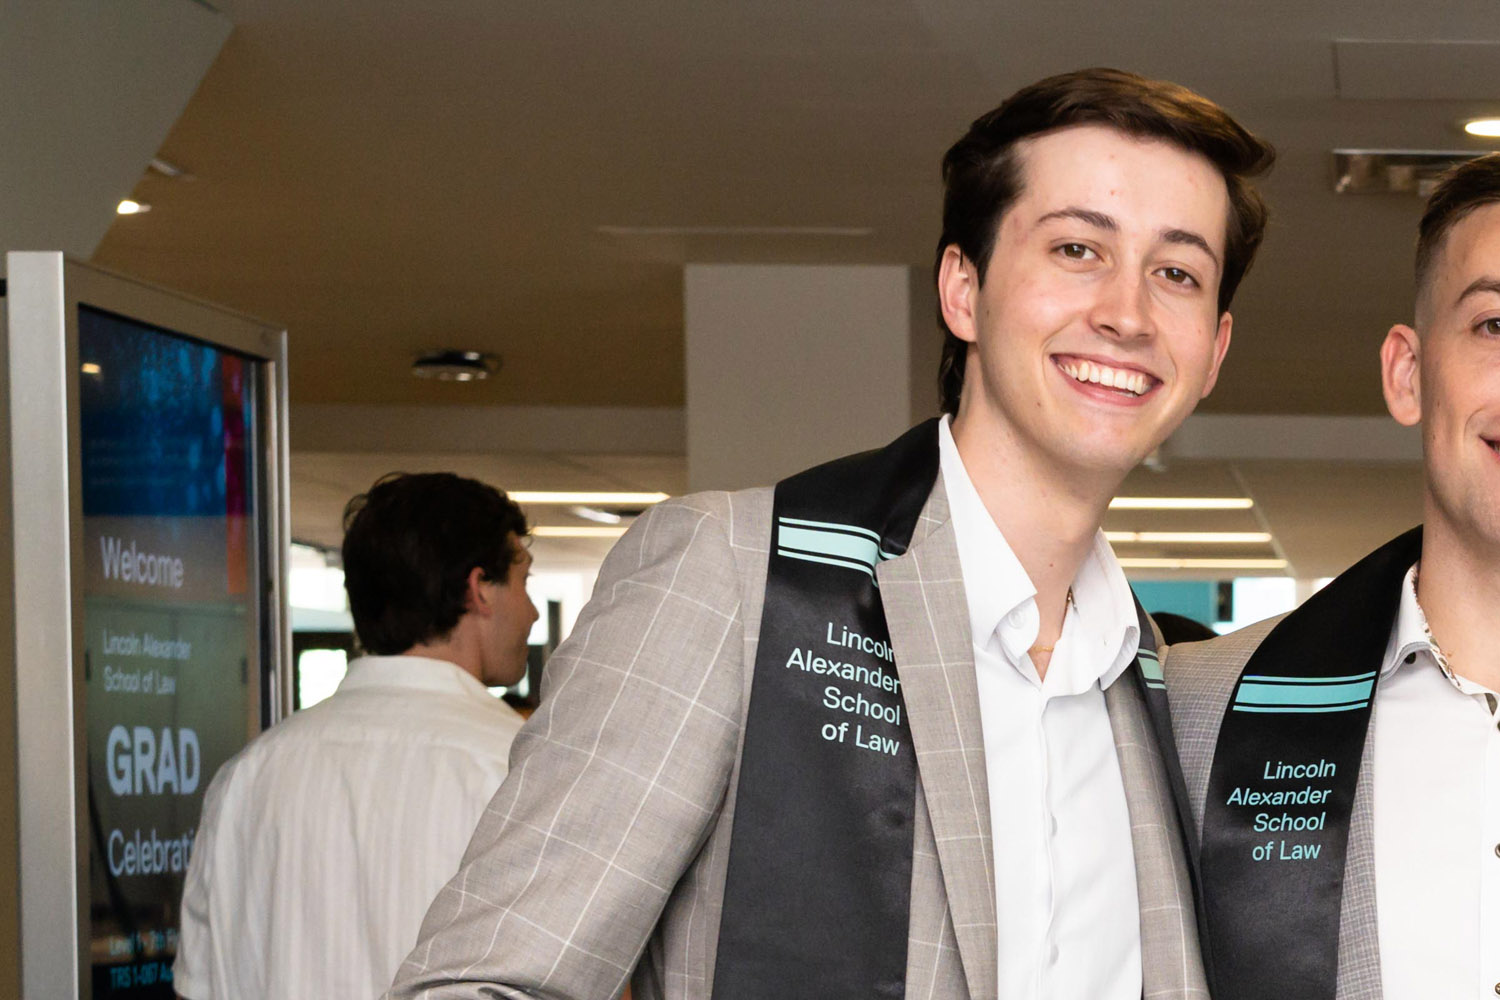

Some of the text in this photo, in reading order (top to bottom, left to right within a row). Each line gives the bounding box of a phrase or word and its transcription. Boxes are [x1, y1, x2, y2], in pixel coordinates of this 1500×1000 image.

[101, 536, 184, 588] Welcome
[103, 628, 192, 660] Lincoln Alexander
[103, 665, 177, 696] School of Law
[786, 647, 901, 694] Alexander
[823, 685, 900, 726] School
[821, 722, 900, 756] of Law
[106, 724, 201, 796] GRAD
[1263, 758, 1337, 780] Lincoln
[1226, 785, 1332, 806] Alexander
[1253, 811, 1327, 832] School
[107, 829, 195, 878] Celebrati
[1252, 840, 1322, 861] of Law
